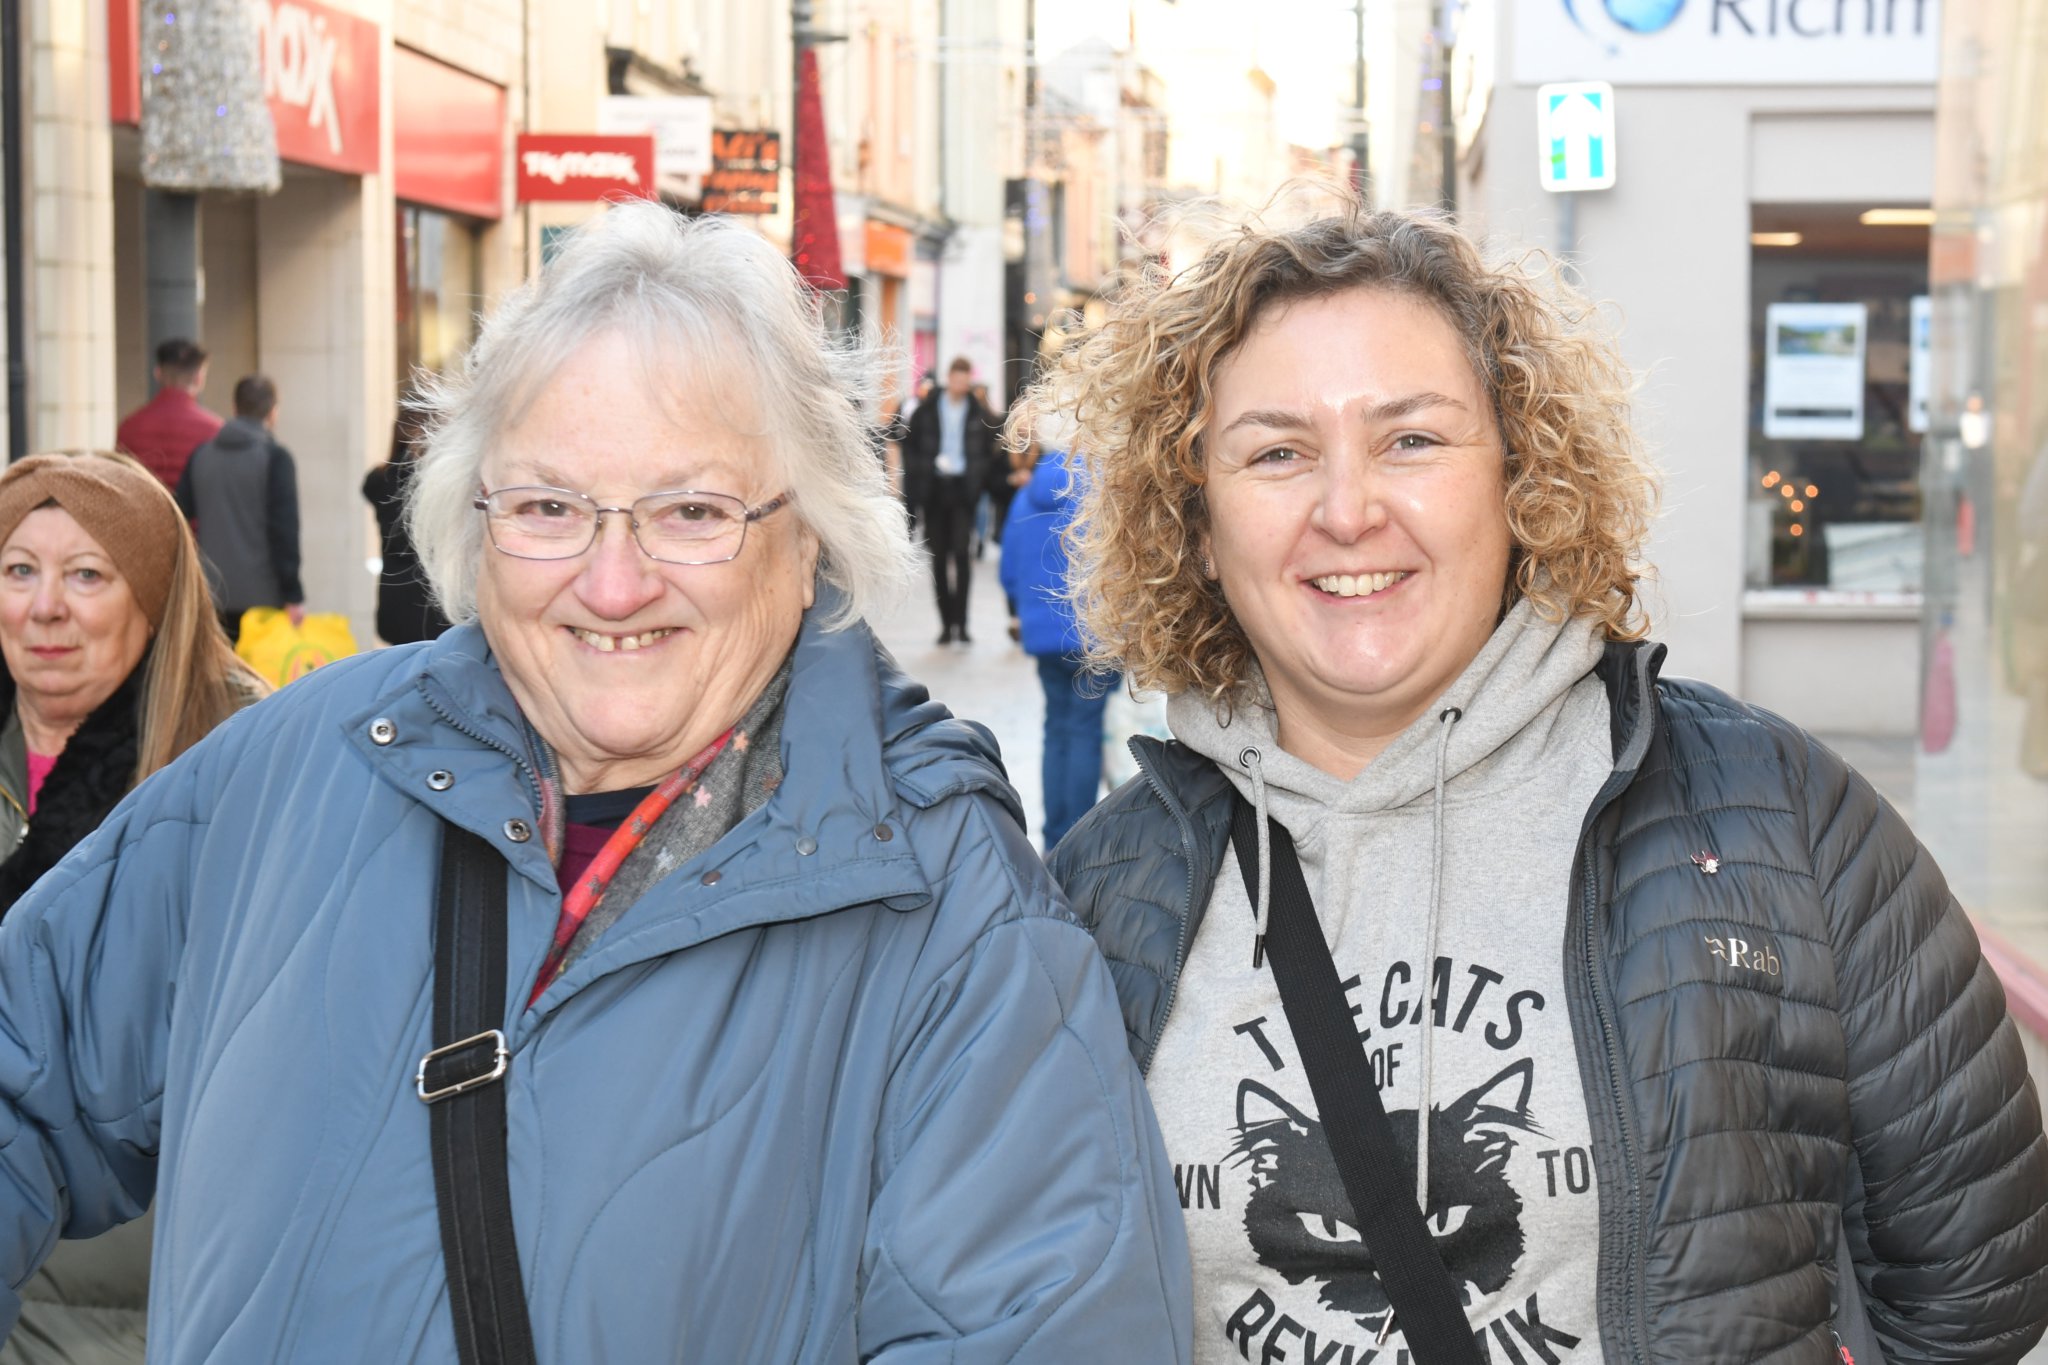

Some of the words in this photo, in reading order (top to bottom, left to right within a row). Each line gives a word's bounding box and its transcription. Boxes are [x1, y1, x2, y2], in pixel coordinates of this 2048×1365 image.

[1727, 937, 1780, 976] Rab
[1232, 974, 1372, 1072] TE
[1379, 955, 1546, 1051] CATS
[1370, 1043, 1404, 1092] OF
[1536, 1145, 1596, 1198] TO
